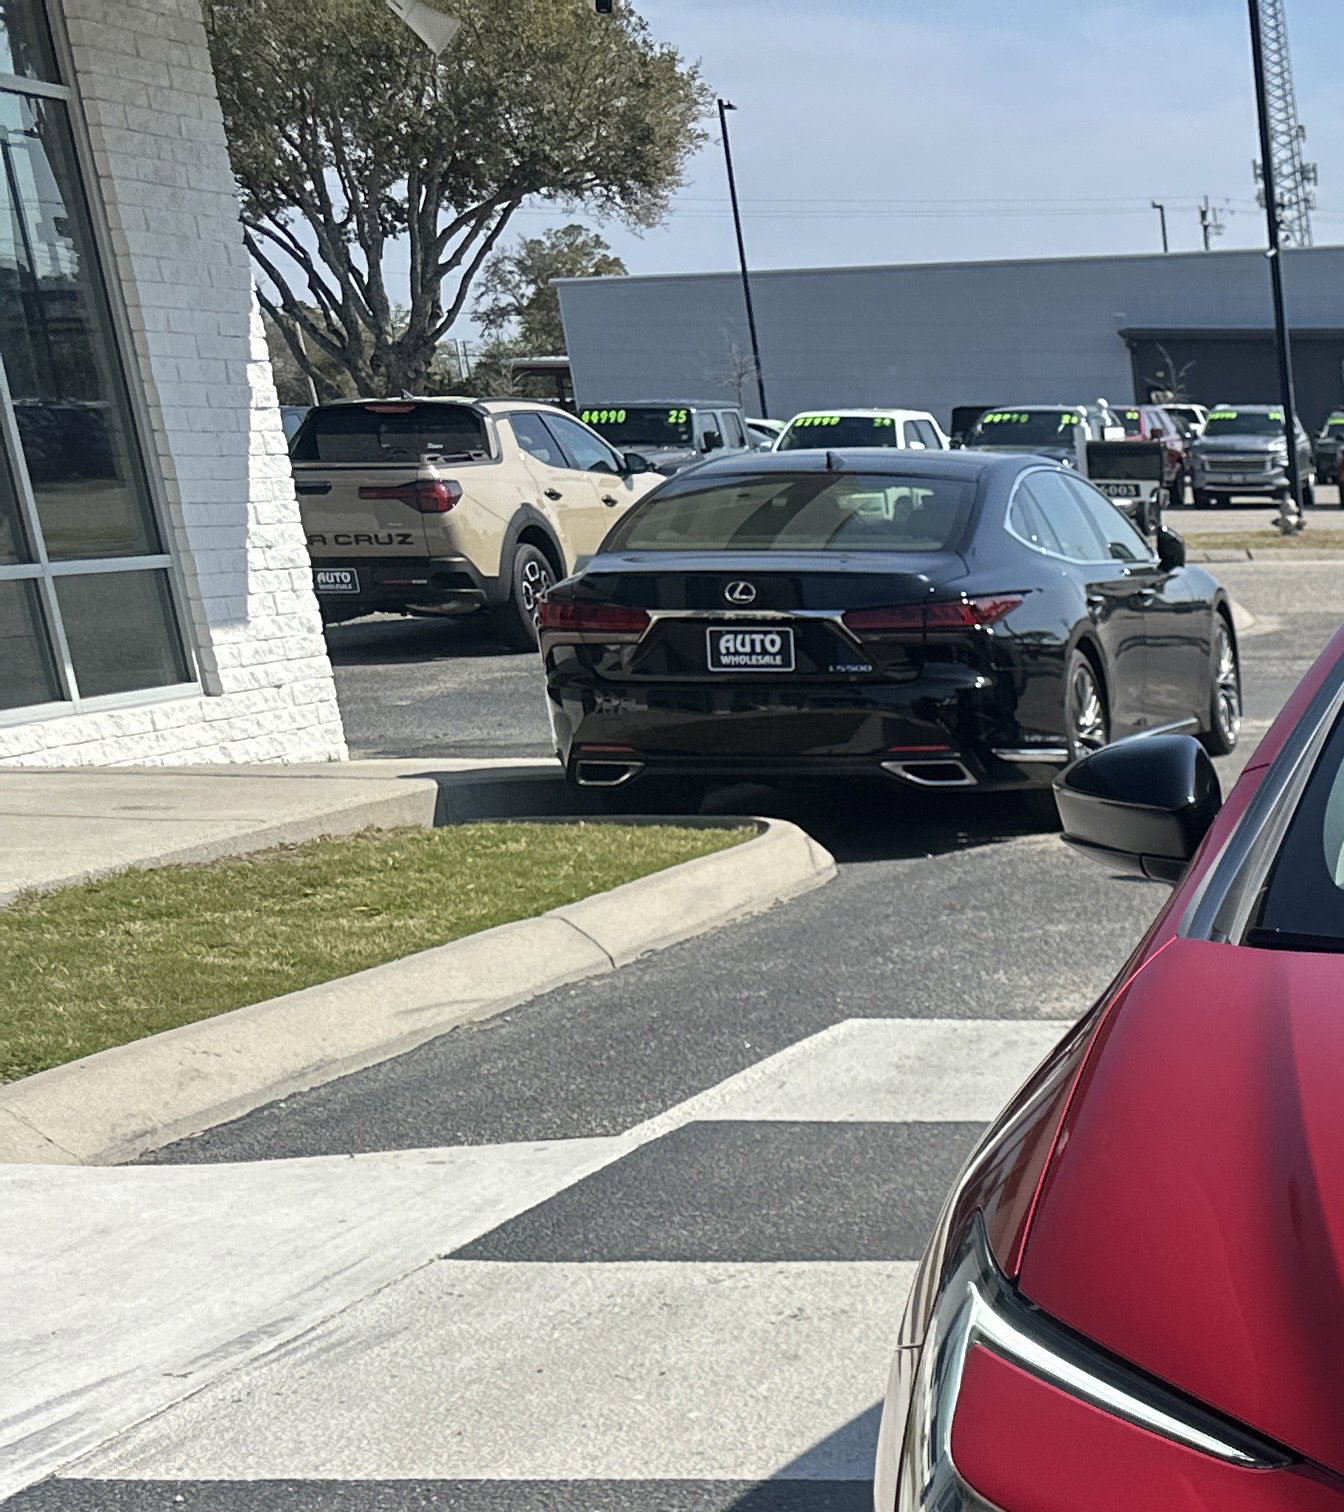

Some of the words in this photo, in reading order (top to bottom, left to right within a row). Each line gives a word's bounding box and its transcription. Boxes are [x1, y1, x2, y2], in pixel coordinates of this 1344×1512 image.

[667, 409, 687, 424] 25
[334, 533, 415, 546] CRUZ
[317, 572, 351, 583] AUTO
[719, 634, 782, 654] AUTO
[720, 655, 783, 666] WHOLESALE
